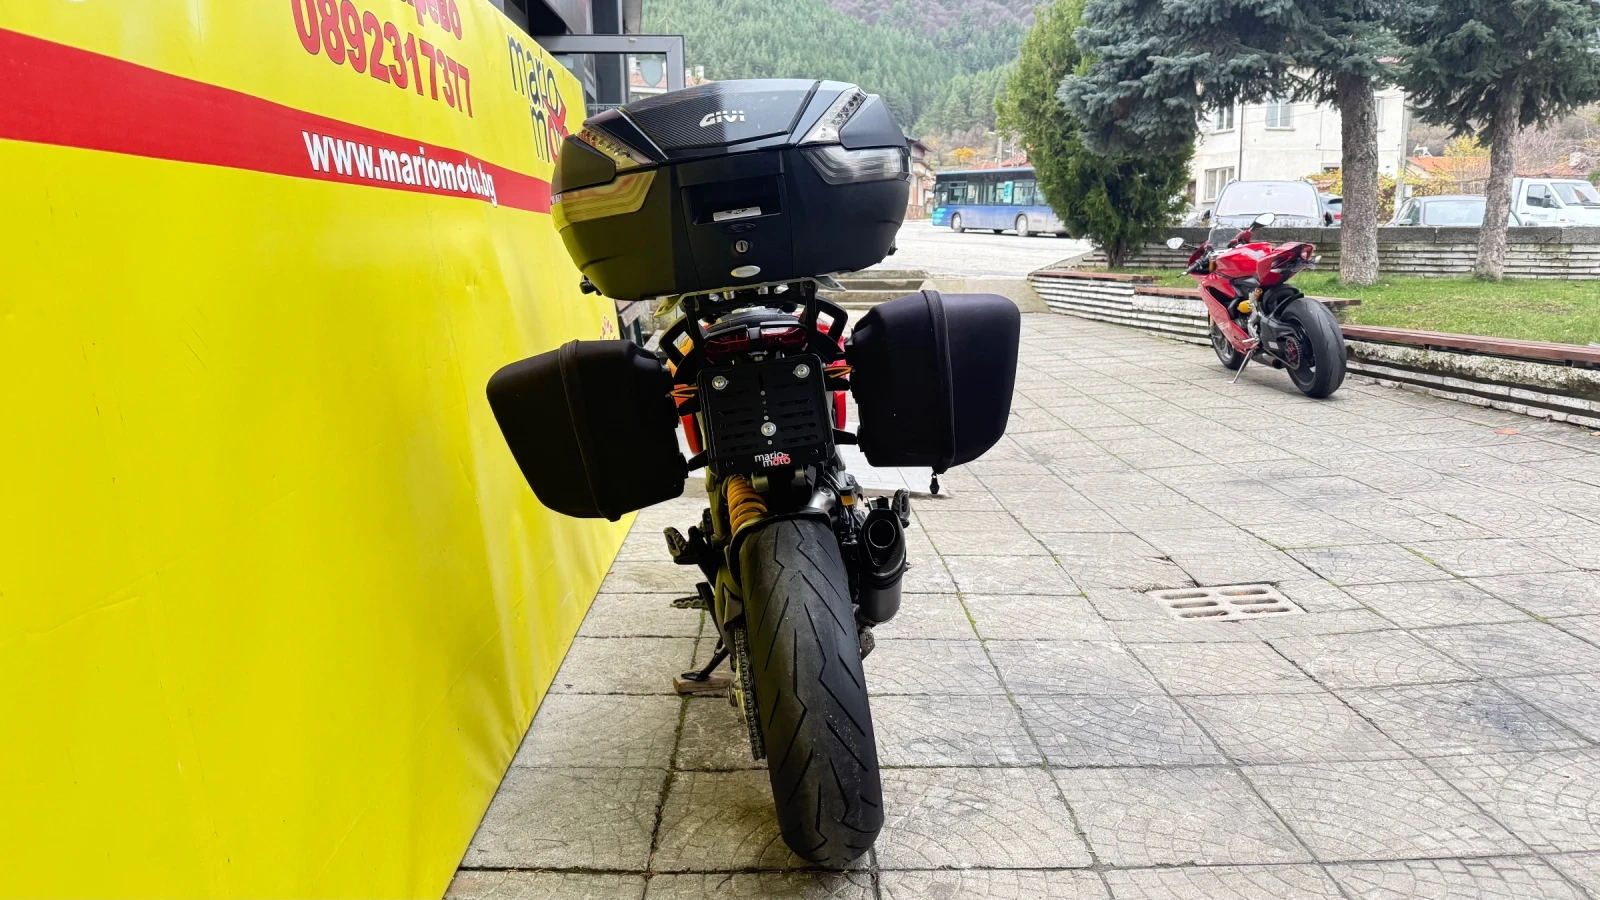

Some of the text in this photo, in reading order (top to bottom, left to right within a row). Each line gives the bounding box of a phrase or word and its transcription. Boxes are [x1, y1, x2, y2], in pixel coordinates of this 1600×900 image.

[291, 0, 473, 118] 0892317377
[507, 34, 560, 112] mario
[699, 110, 746, 128] GIVI
[301, 130, 498, 208] www.mariomoto.bg
[754, 450, 784, 462] mario
[763, 455, 791, 467] moto
